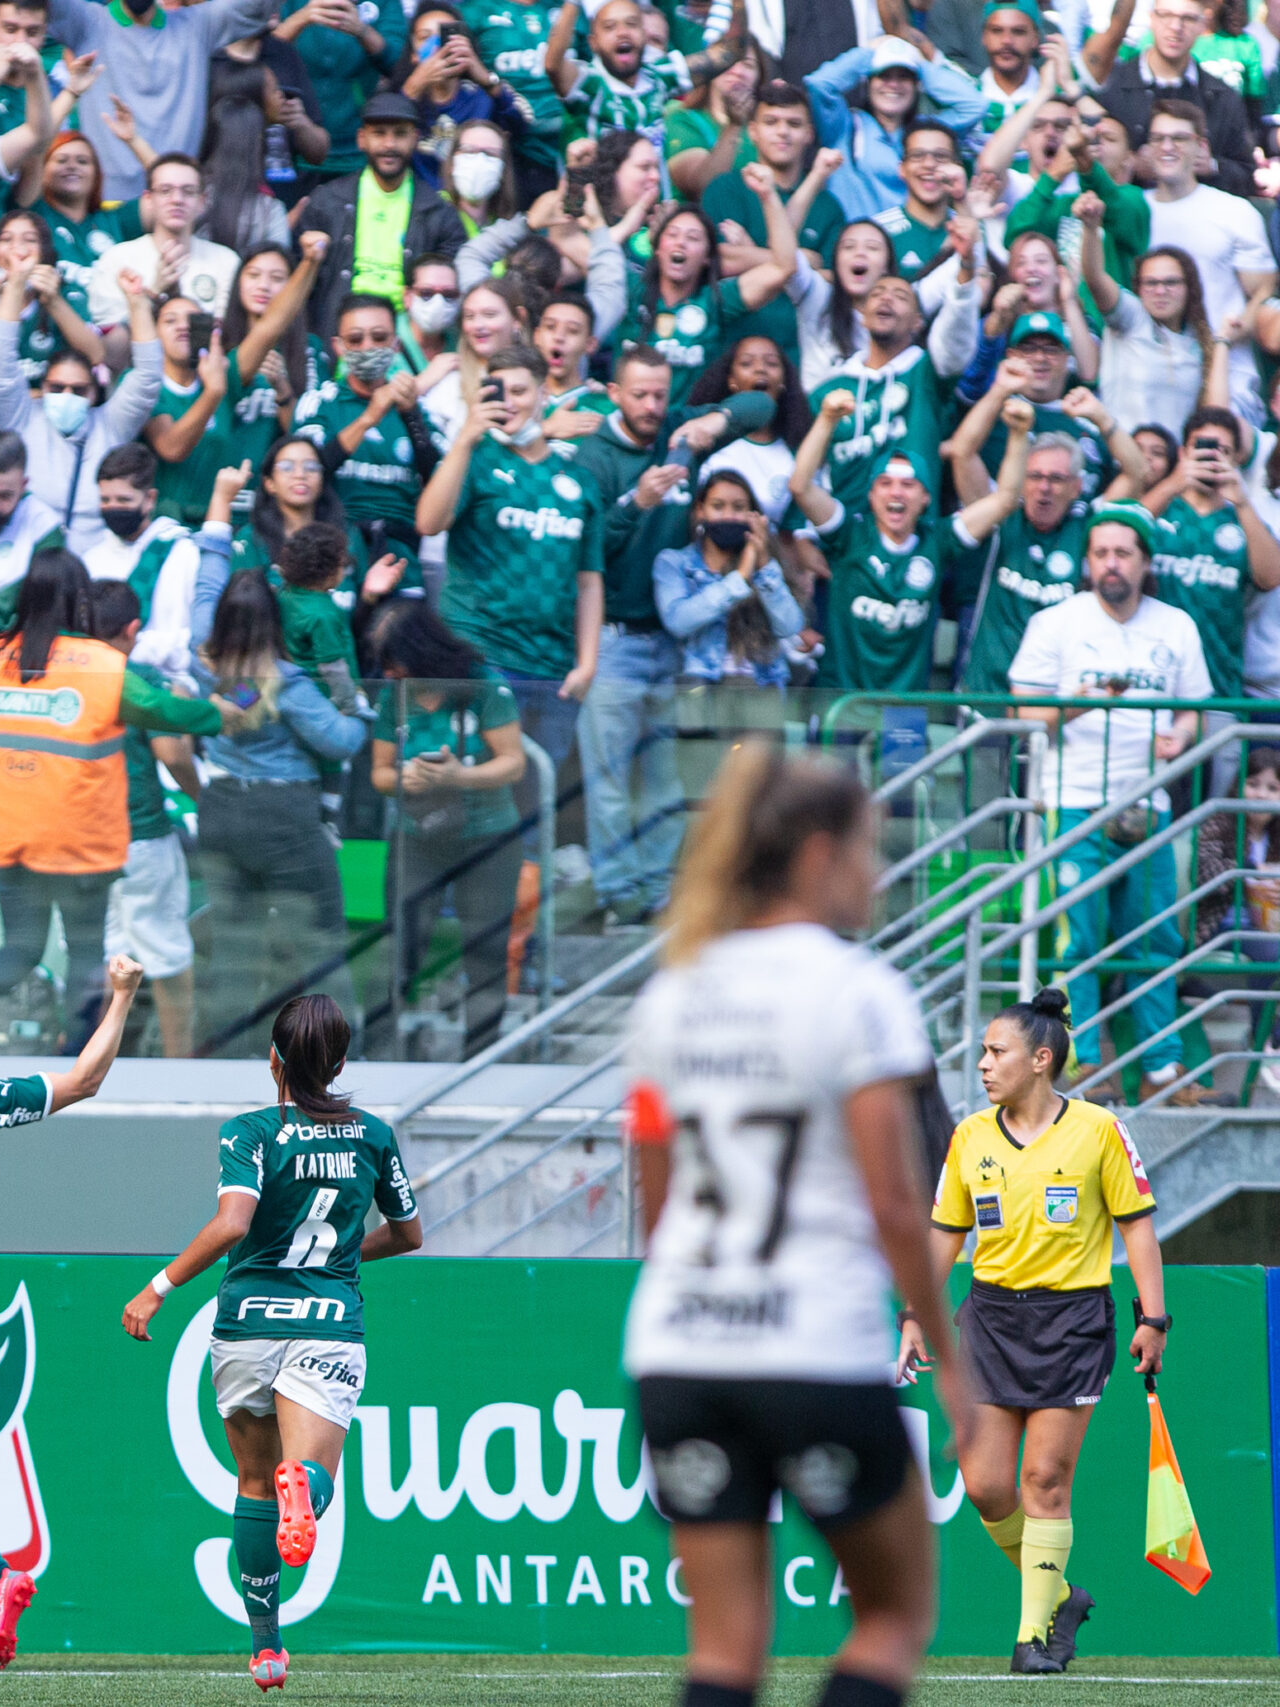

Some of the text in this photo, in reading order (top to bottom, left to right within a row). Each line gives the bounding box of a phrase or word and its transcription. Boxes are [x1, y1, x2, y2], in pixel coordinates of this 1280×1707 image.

[497, 506, 585, 541] crefisa
[297, 1119, 367, 1142] betfair
[294, 1151, 357, 1181] KATRINE
[390, 1155, 414, 1212] crefisa
[299, 1354, 359, 1389] crefisa
[167, 1297, 968, 1627] Guar
